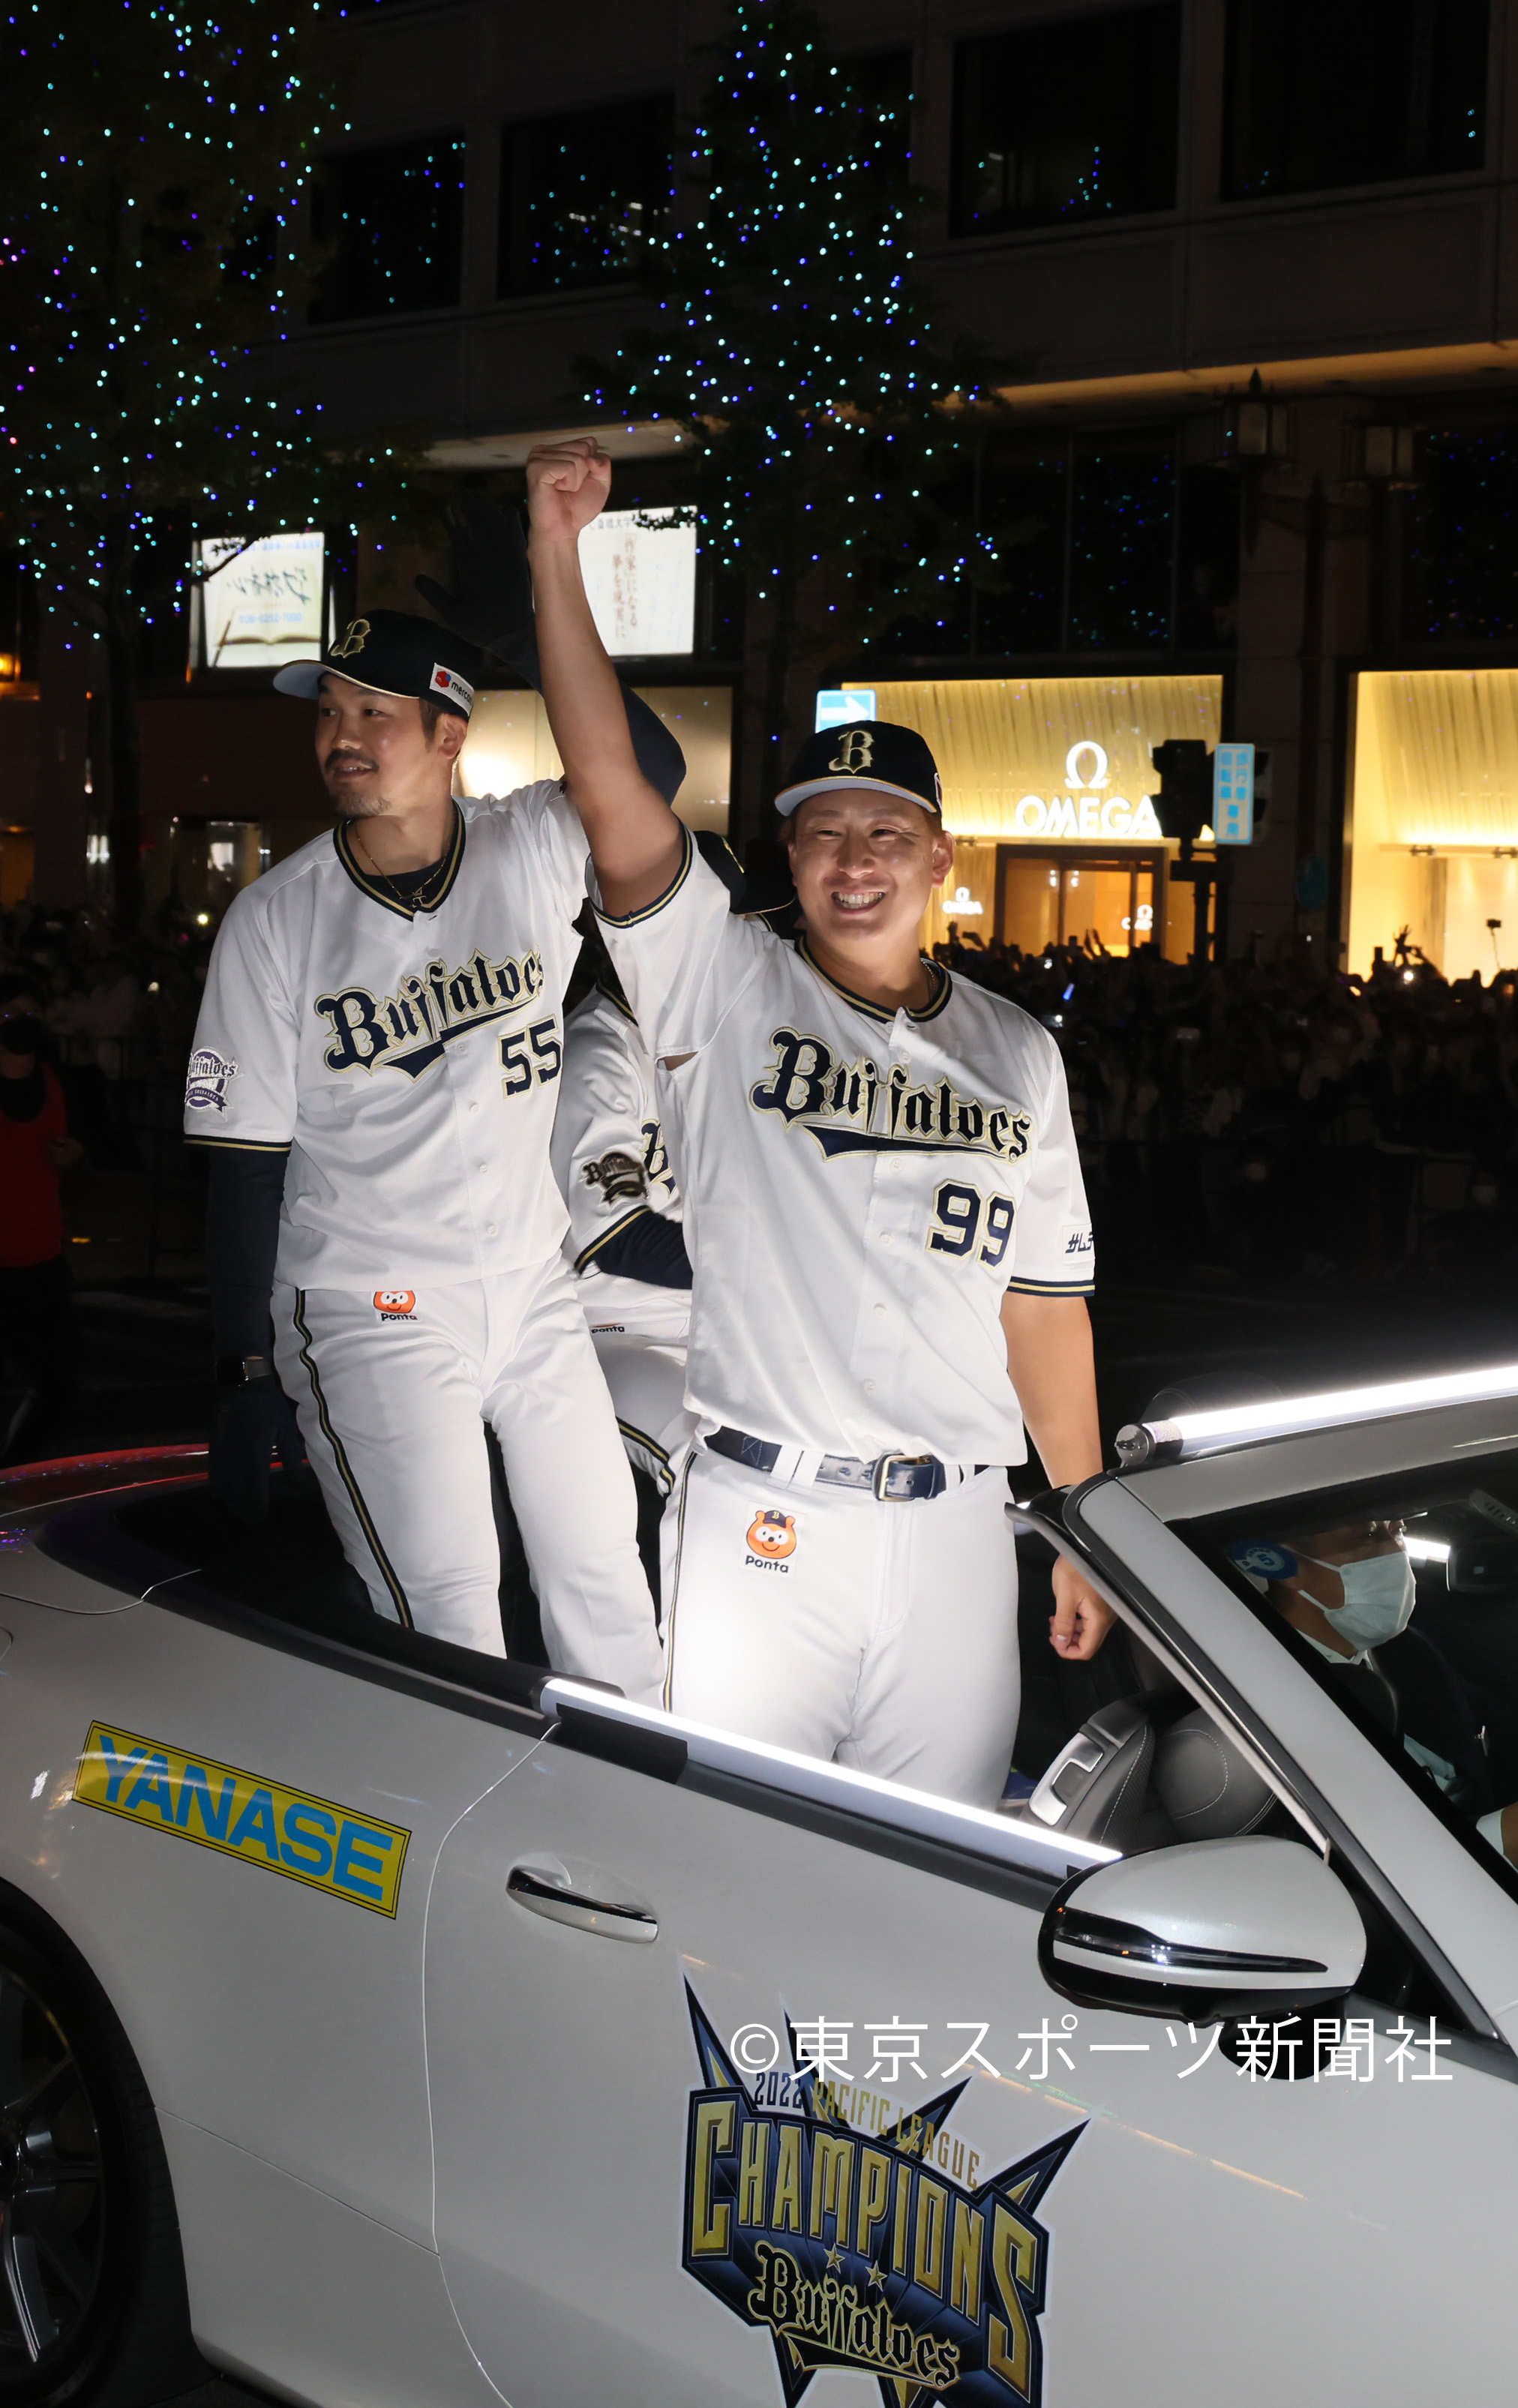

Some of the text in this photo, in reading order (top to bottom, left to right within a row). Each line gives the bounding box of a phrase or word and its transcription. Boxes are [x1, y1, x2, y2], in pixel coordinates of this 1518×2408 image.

[331, 619, 371, 658] B
[828, 730, 875, 774] B
[1016, 795, 1162, 838] OMEGA
[498, 1014, 562, 1099] 55
[749, 1026, 1031, 1164] Buffaloes
[926, 1178, 1015, 1267] 99
[746, 1555, 789, 1573] Ponta
[99, 1735, 393, 1901] YANASE
[754, 2071, 980, 2190] 2022 PACIFIC LEAGUE
[691, 2100, 1038, 2404] CHAMPIONS
[748, 2240, 962, 2390] Buffaloes
